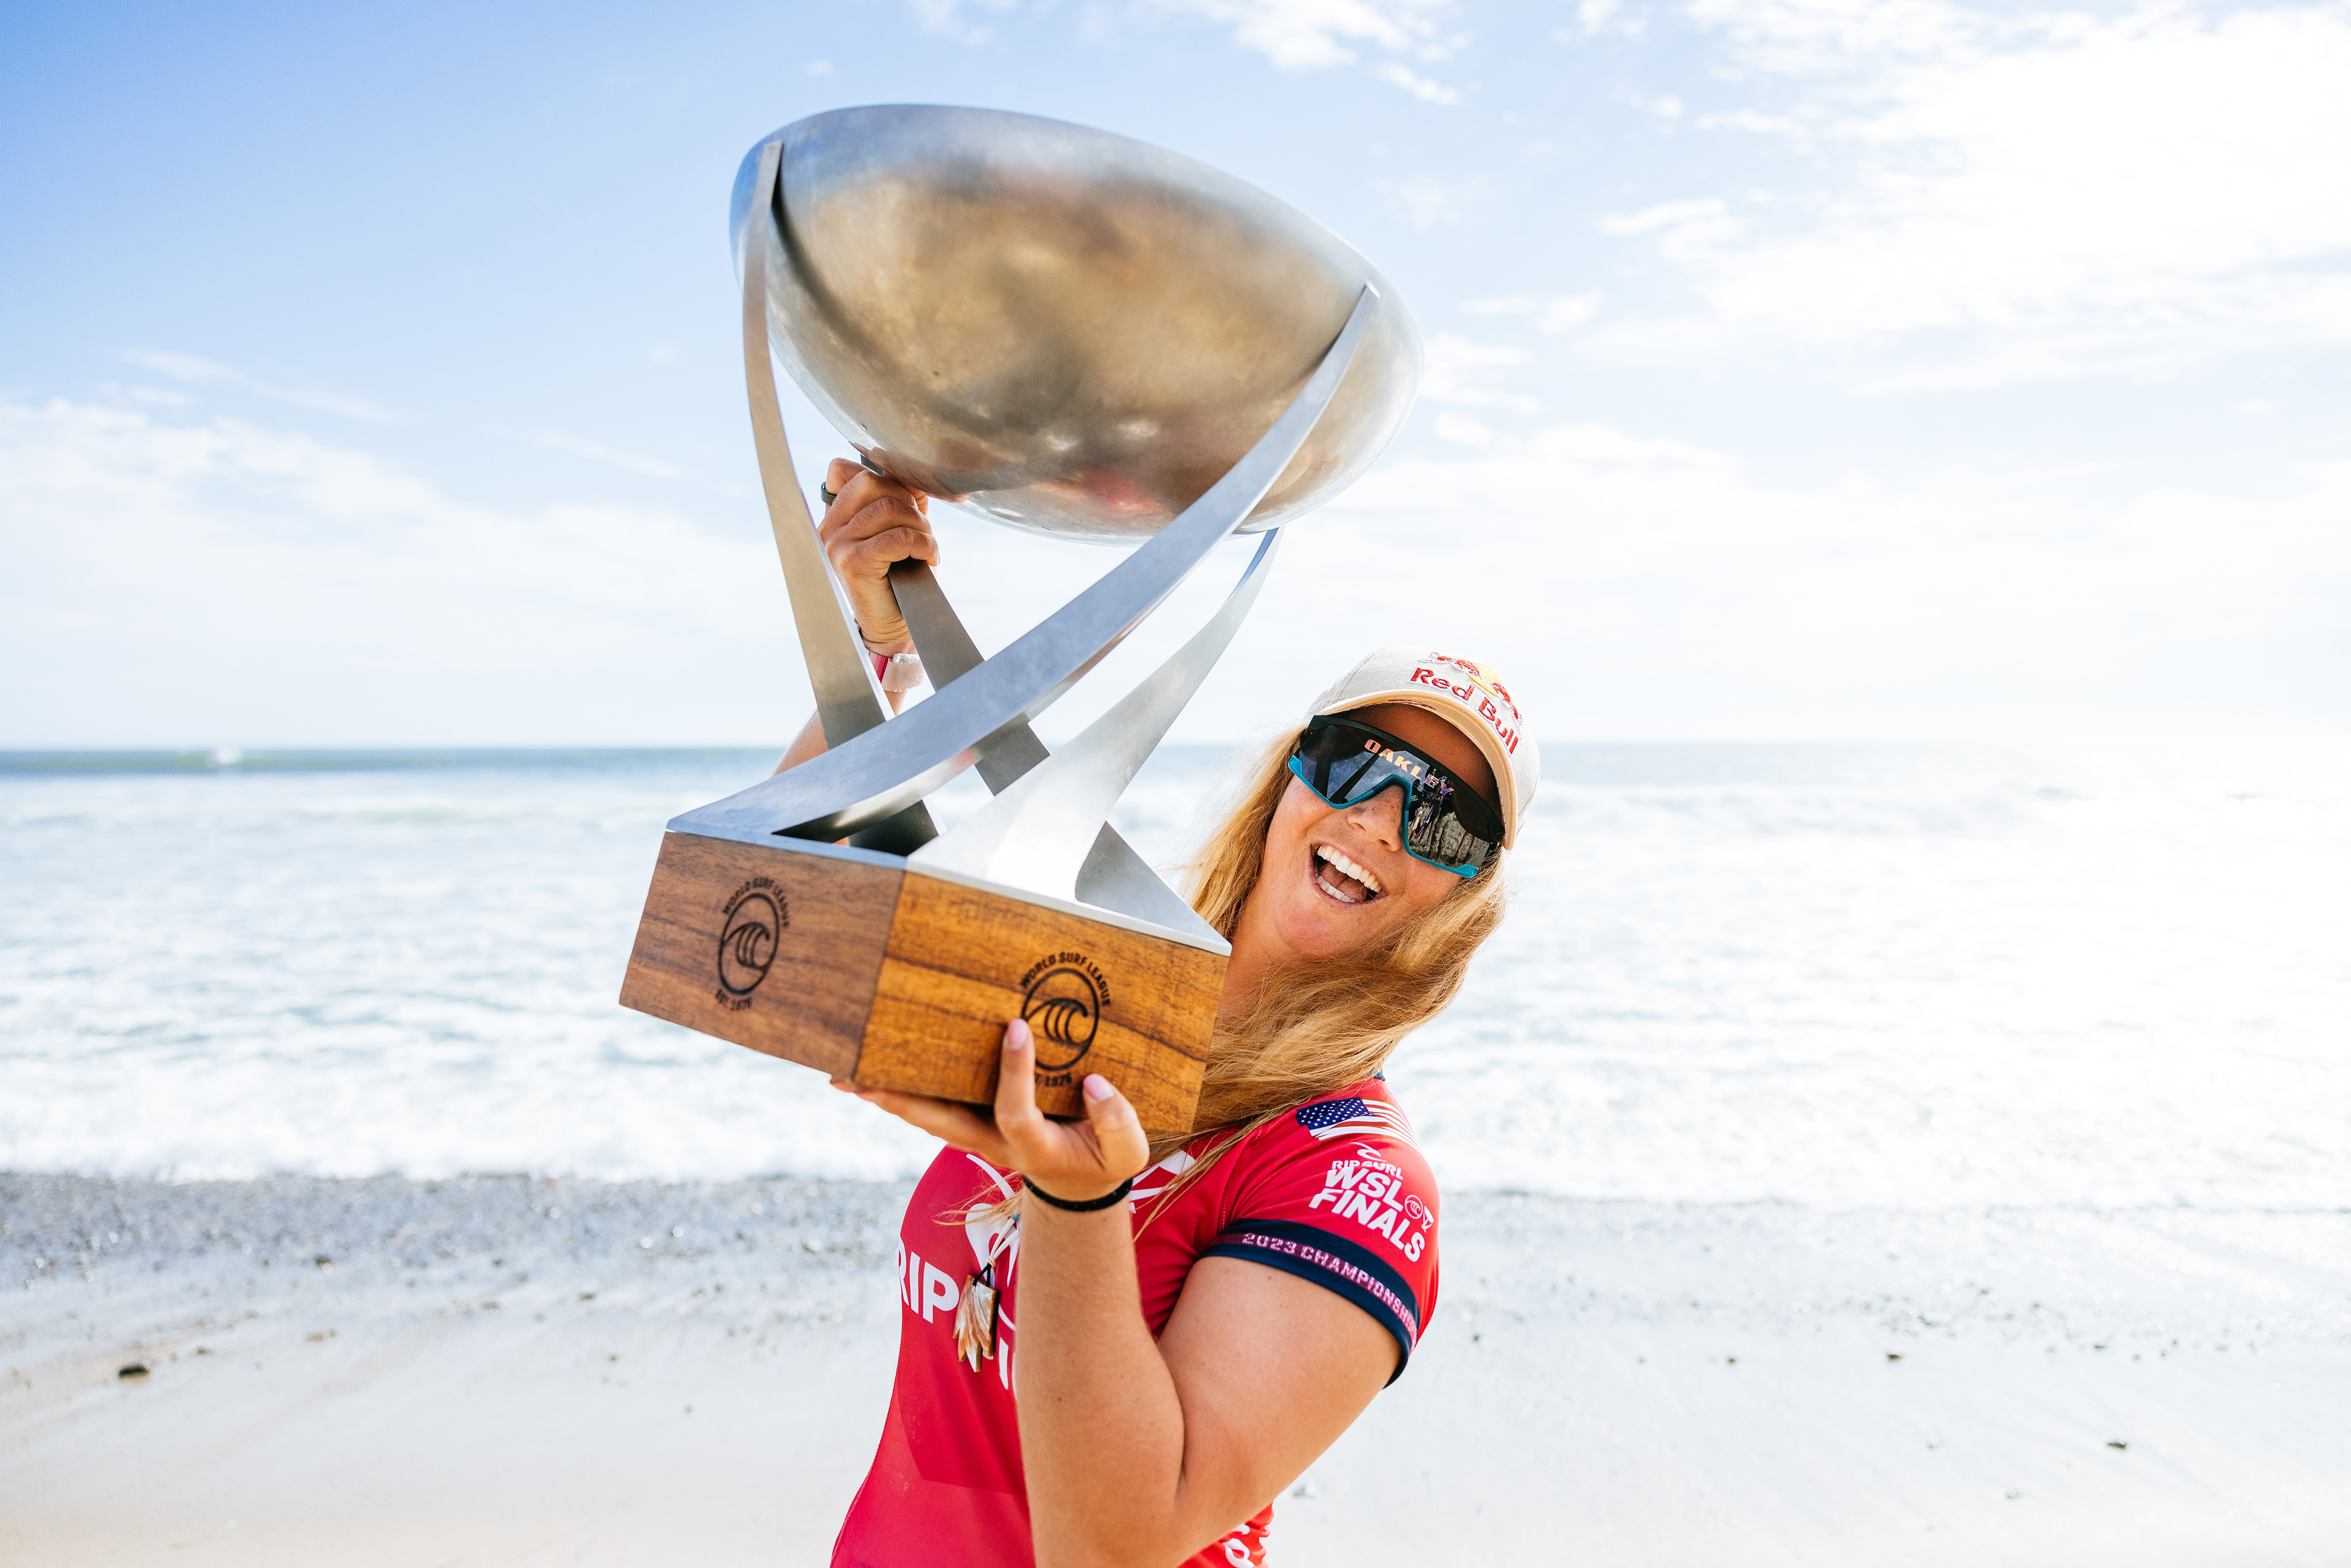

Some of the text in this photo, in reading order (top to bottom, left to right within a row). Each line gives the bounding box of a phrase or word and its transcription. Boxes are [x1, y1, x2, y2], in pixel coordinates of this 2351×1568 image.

[1409, 667, 1519, 755] Red Bull
[1363, 738, 1455, 796] OAKLEY
[1019, 951, 1112, 1007] WORLD SURF LEAGUE
[1324, 1166, 1404, 1212] WSL
[1242, 1232, 1297, 1255] 2023
[1308, 1187, 1425, 1262] FINALS
